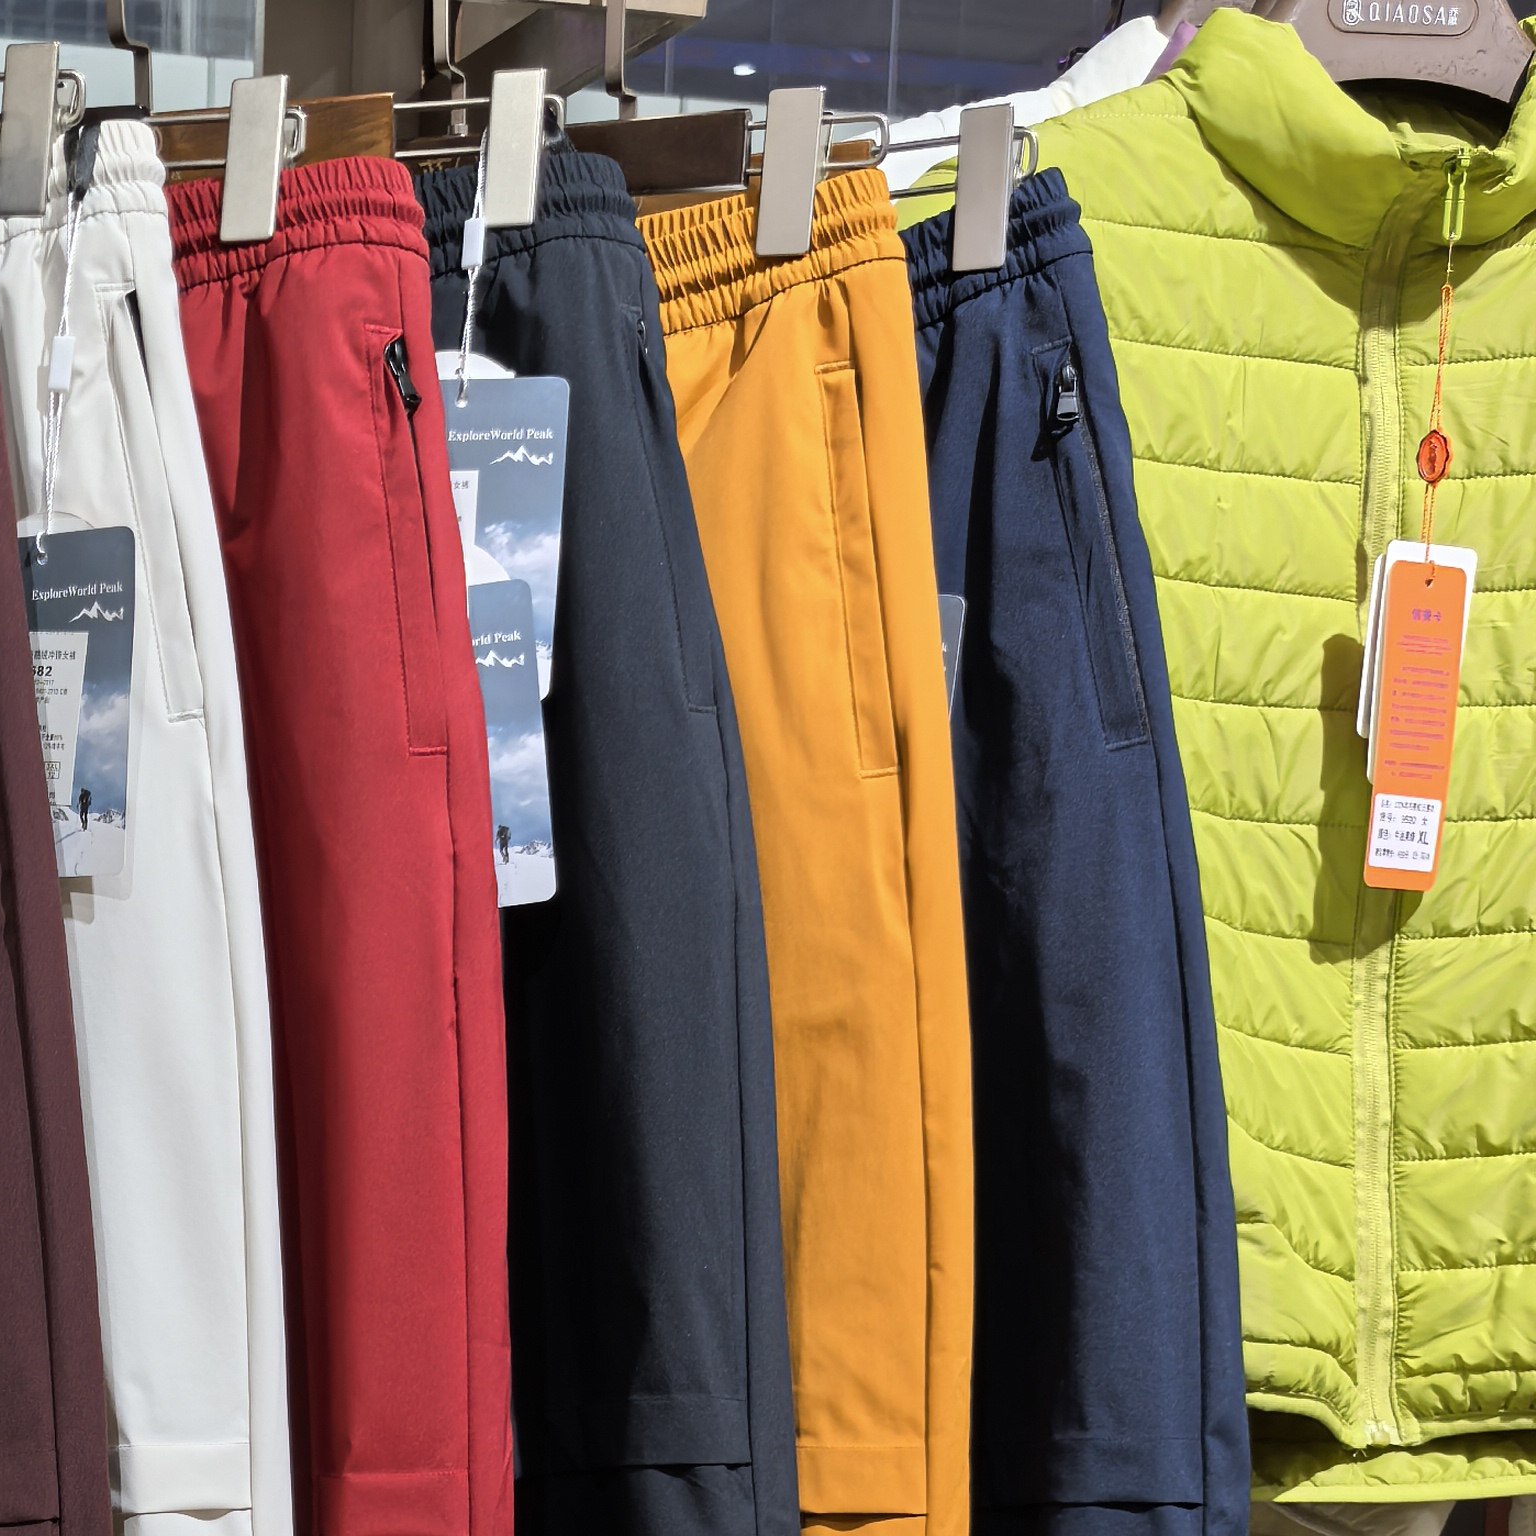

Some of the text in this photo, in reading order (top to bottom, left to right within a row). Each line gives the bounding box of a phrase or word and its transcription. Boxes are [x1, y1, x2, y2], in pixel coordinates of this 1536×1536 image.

[1369, 1, 1446, 25] QIAOSA
[448, 427, 553, 442] ExploreWorld Peak
[32, 580, 124, 601] ExploreWorld Peak
[493, 630, 522, 644] Peak
